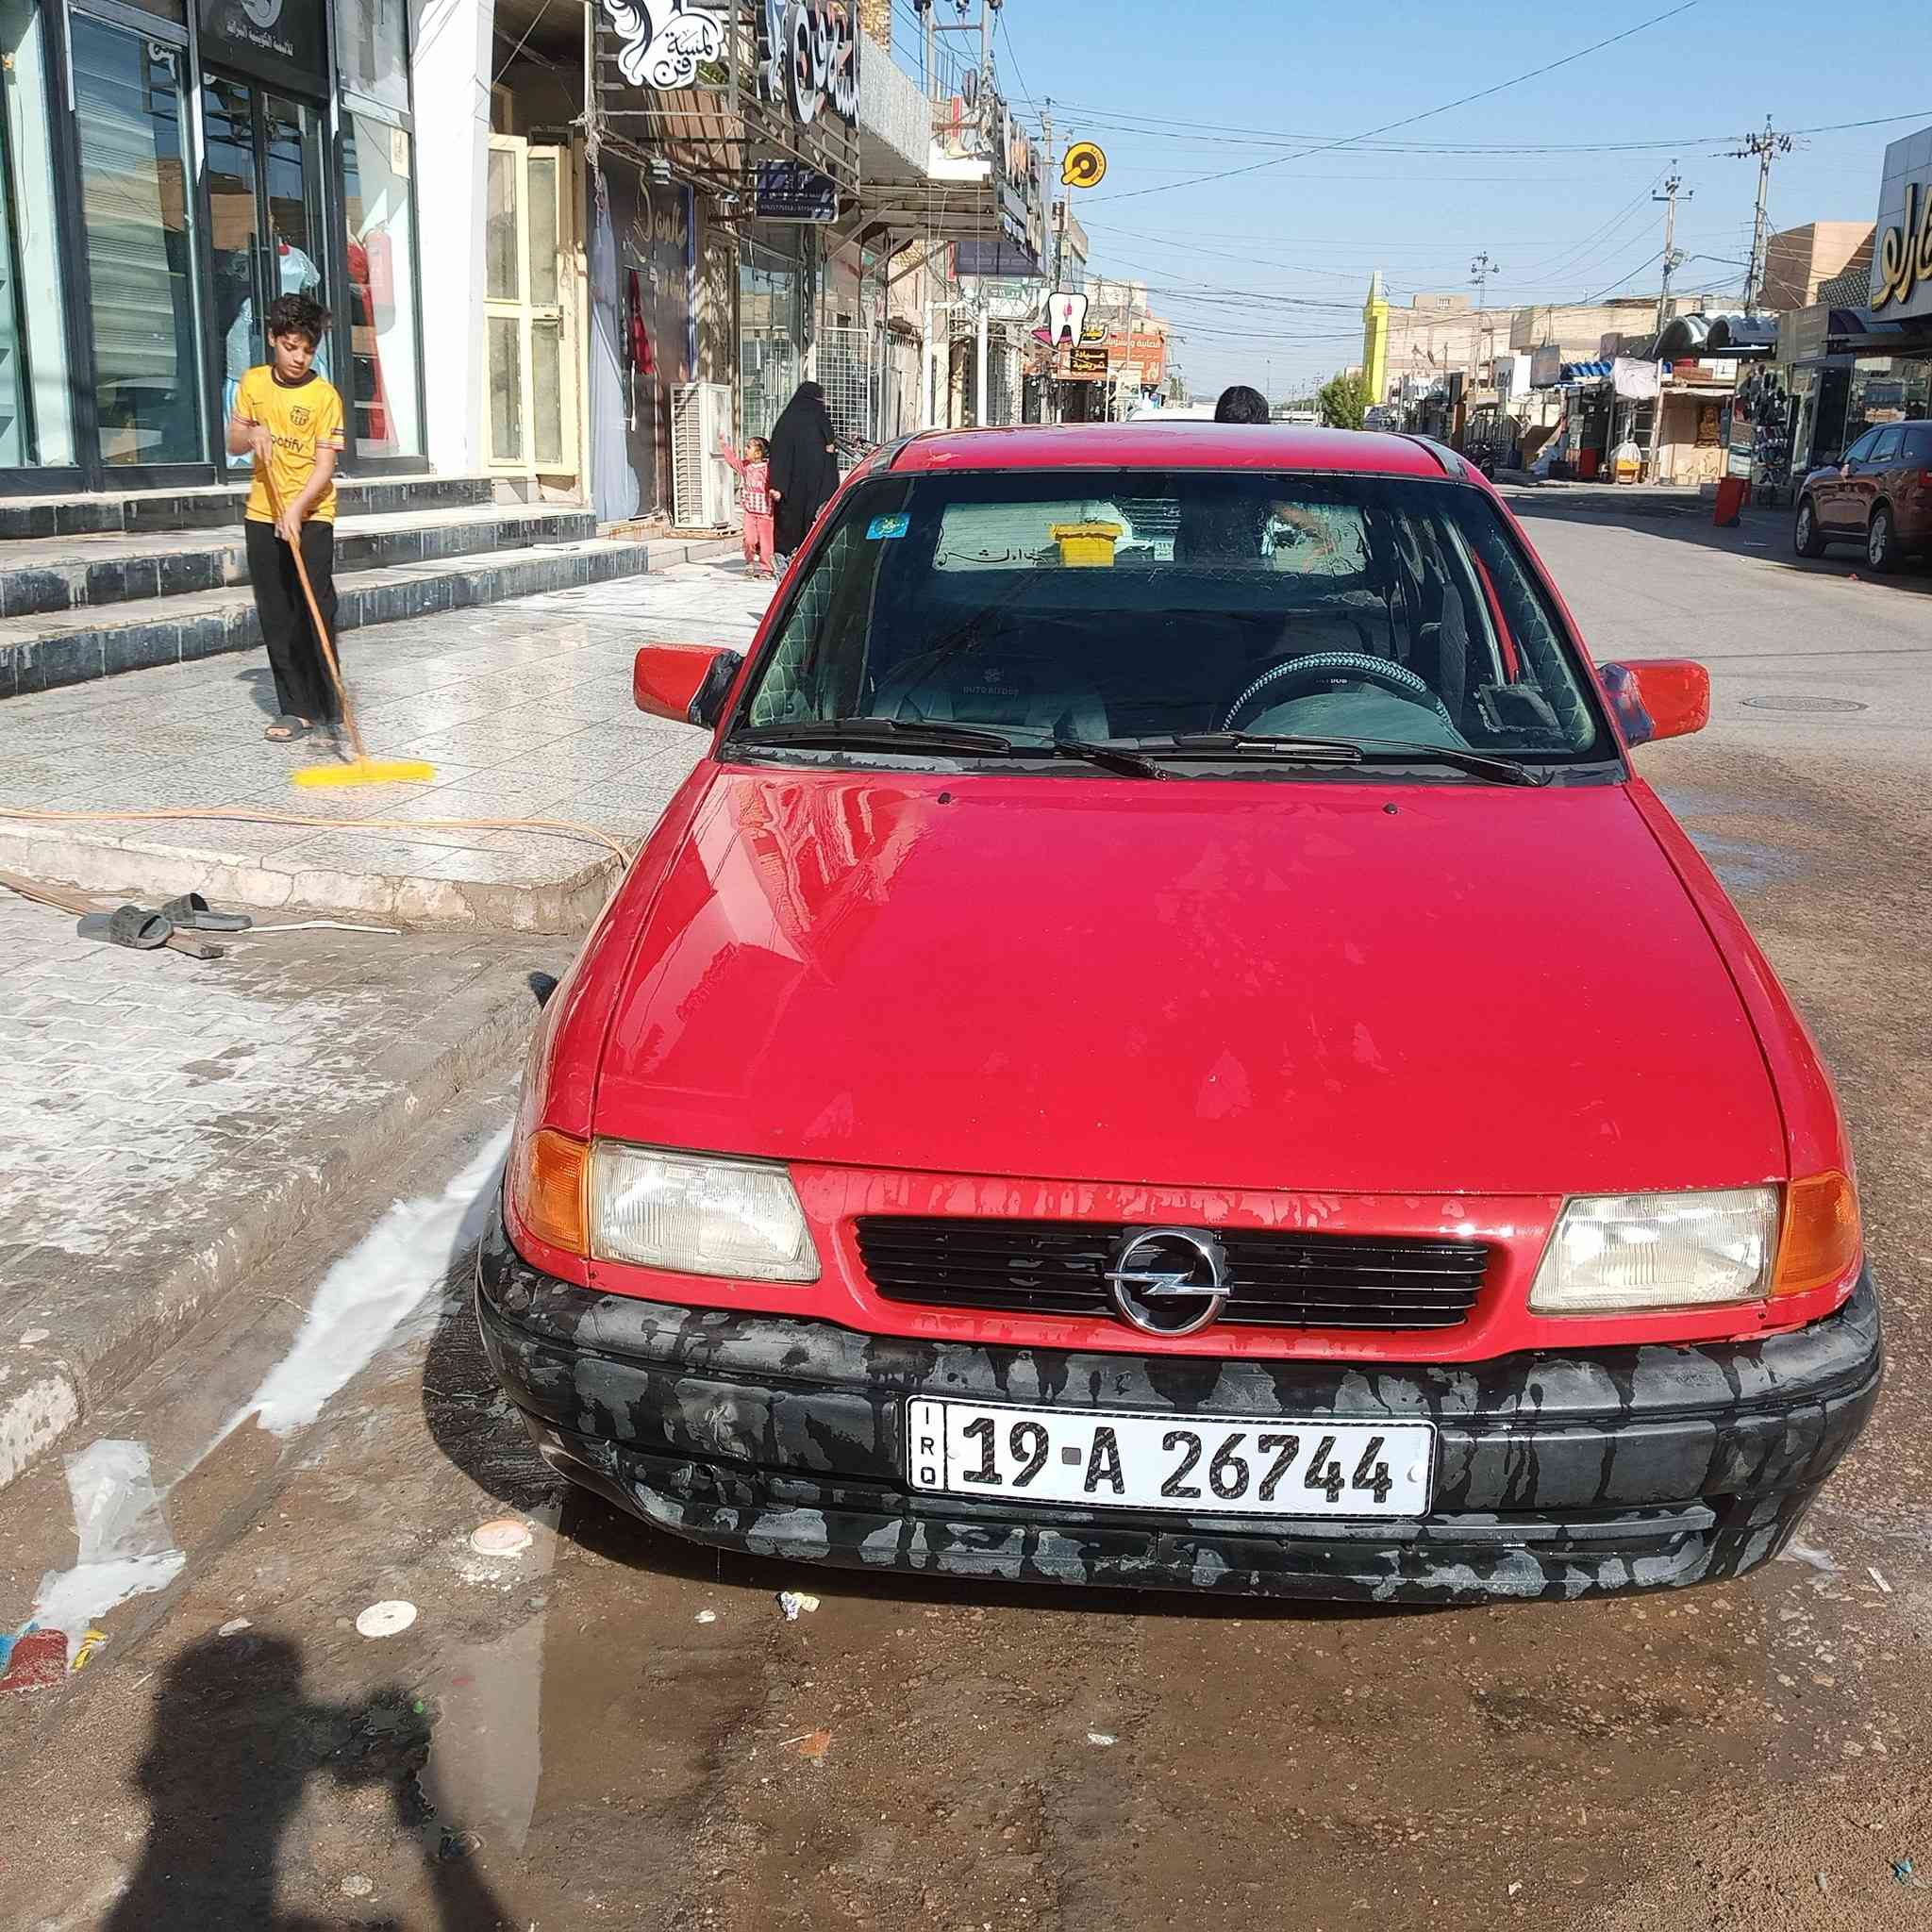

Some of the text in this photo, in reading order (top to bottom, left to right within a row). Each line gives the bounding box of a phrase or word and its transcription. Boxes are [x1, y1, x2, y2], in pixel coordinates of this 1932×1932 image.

[667, 24, 713, 56] لمسة
[653, 57, 691, 87] فن
[271, 435, 304, 453] otify
[1159, 1430, 1393, 1504] 26744
